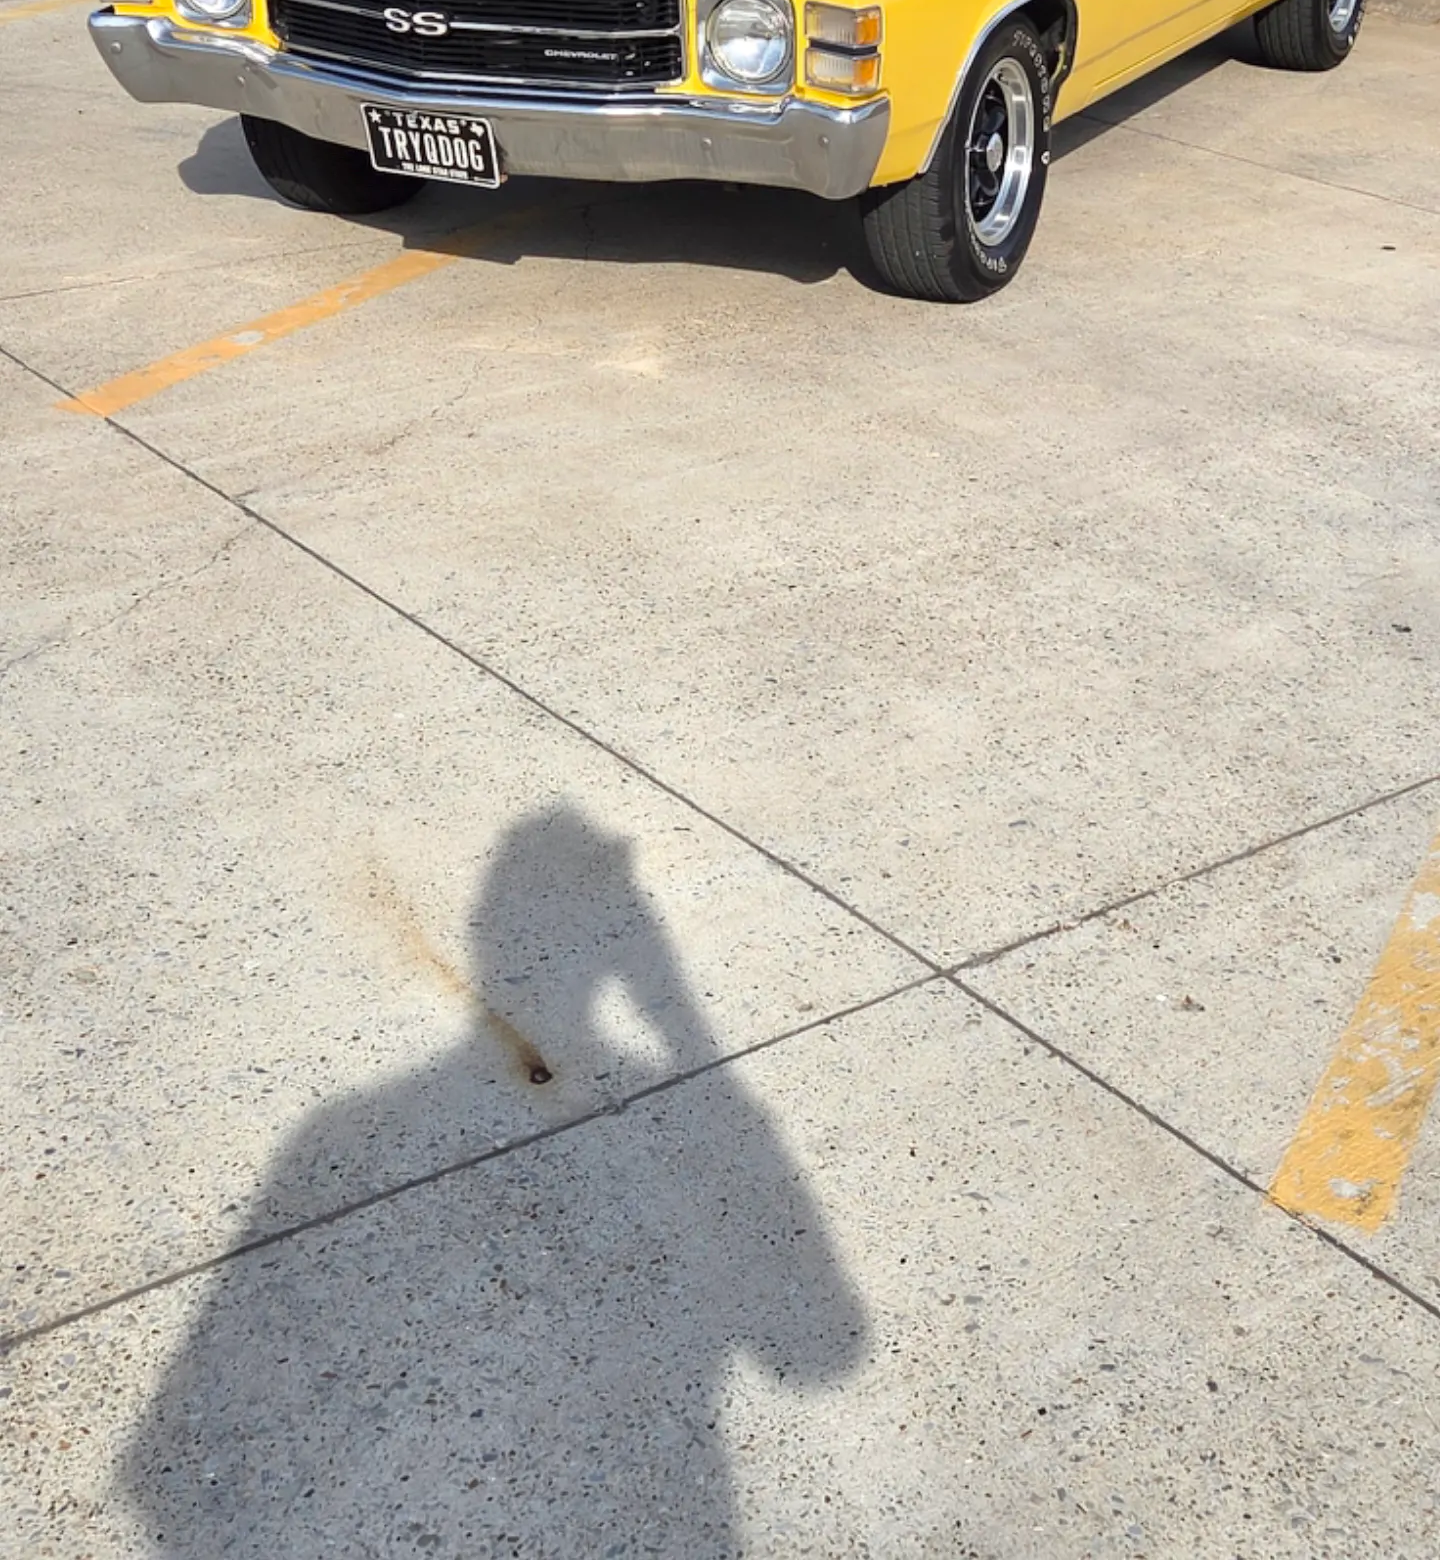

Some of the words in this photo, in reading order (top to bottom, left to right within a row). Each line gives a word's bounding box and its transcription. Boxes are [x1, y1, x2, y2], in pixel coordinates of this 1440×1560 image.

[383, 7, 448, 37] SS
[543, 48, 618, 61] CHEVROLET
[392, 111, 462, 135] TEXAS
